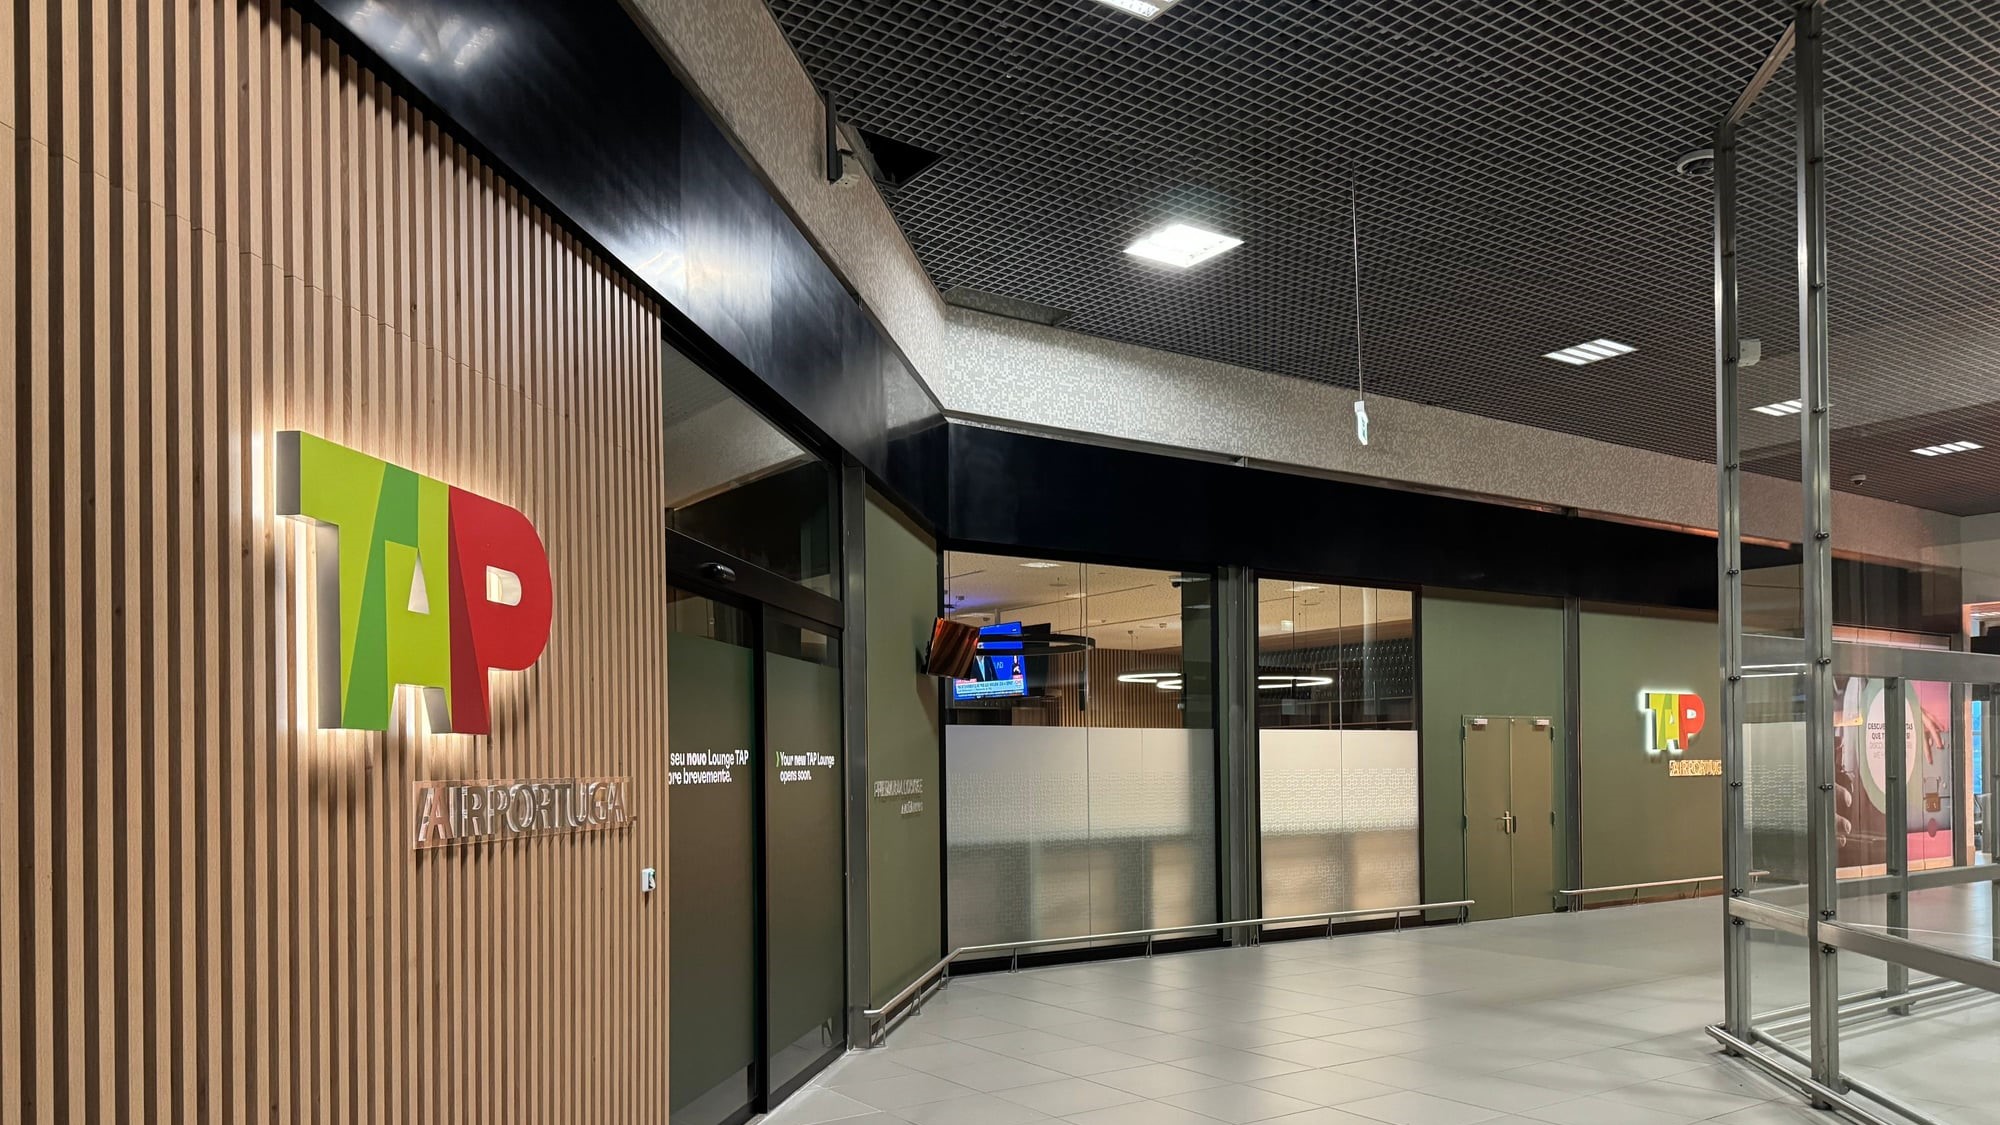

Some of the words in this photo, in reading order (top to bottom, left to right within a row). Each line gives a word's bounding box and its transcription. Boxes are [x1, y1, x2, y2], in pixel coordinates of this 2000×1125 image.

[276, 430, 553, 735] TAP
[1645, 692, 1706, 750] TAP
[670, 752, 685, 766] seu
[686, 752, 707, 766] novo
[708, 748, 735, 769] Lounge
[734, 749, 750, 765] TAP
[780, 751, 793, 767] Your
[794, 755, 807, 766] new
[806, 751, 817, 766] TAP
[817, 751, 835, 769] Lounge
[683, 767, 733, 784] brevemente.
[780, 770, 797, 785] opens
[797, 769, 812, 781] soon.
